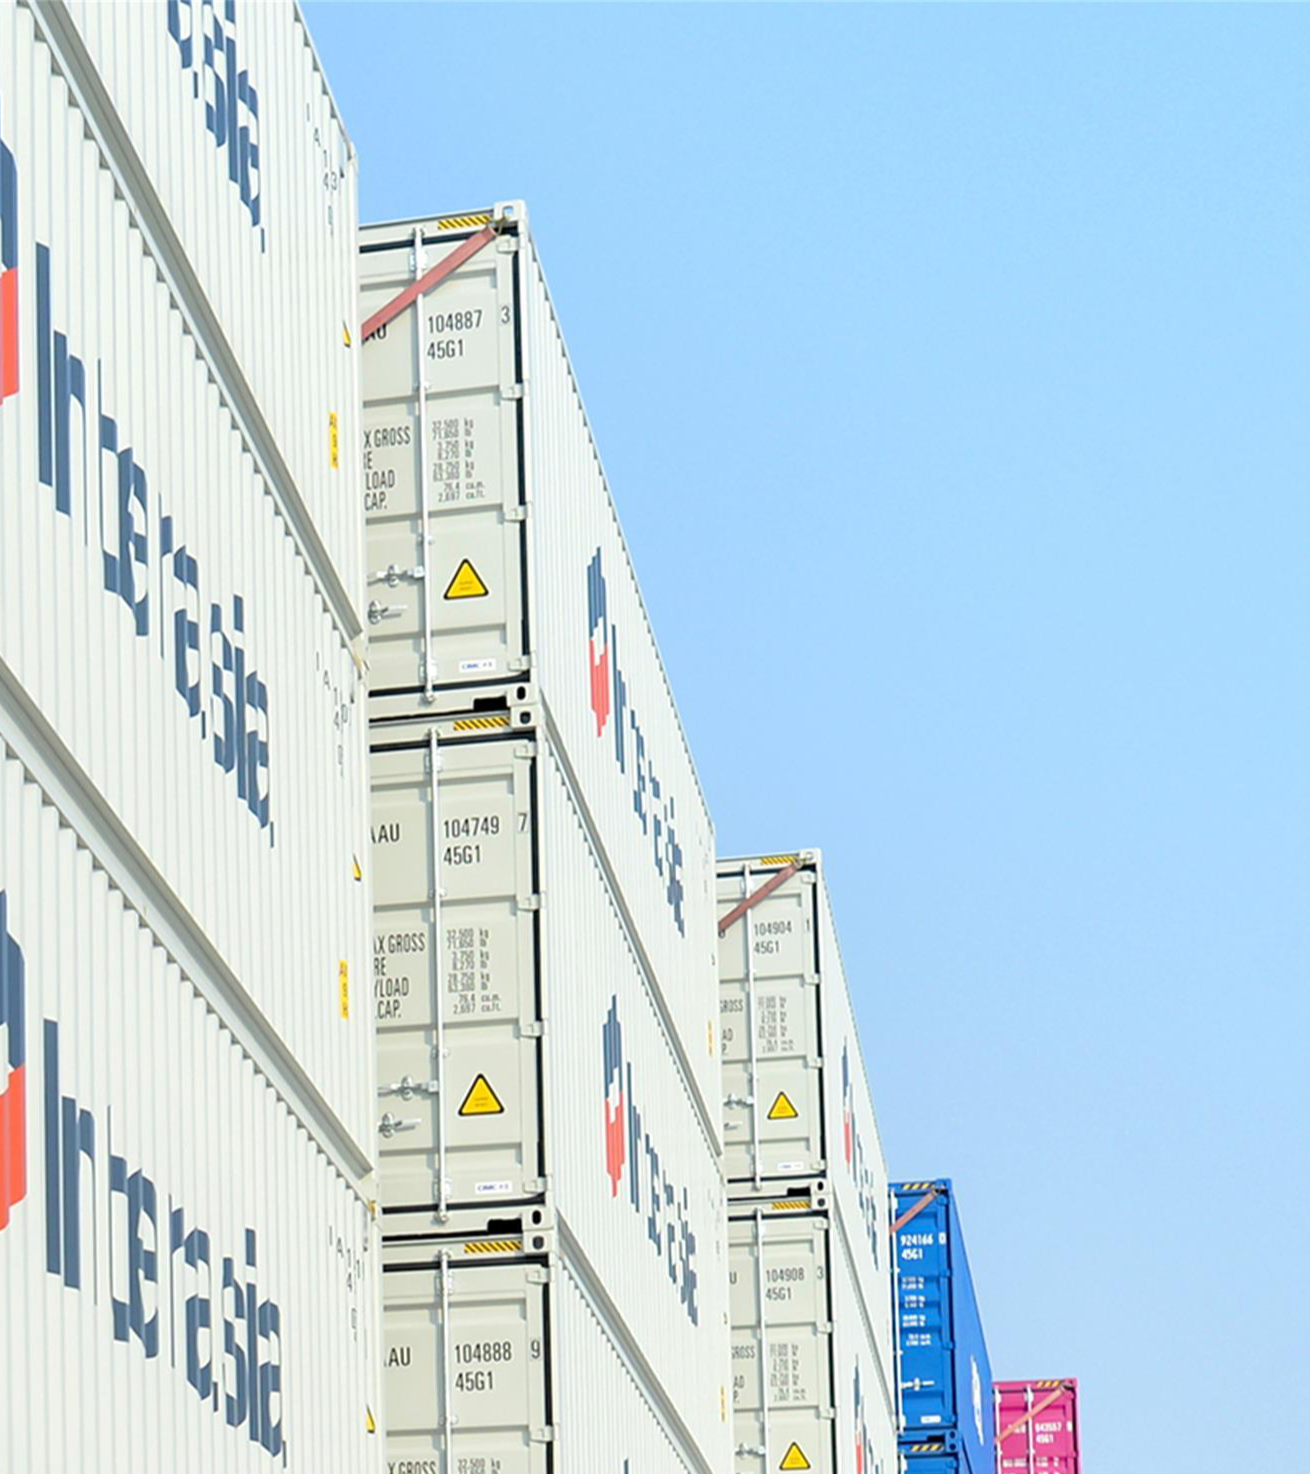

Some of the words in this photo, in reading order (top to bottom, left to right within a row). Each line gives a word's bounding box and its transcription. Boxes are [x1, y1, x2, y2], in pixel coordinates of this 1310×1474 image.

[428, 309, 483, 334] 104887
[500, 306, 511, 325] 3
[427, 338, 464, 361] 45G1
[374, 426, 412, 447] GROSS
[444, 815, 499, 838] 104749
[518, 813, 528, 832] 7
[444, 845, 480, 865] 45G1
[388, 933, 426, 952] GROSS
[753, 941, 779, 954] 45G1
[766, 1287, 792, 1300] 45G1
[384, 1347, 411, 1367] AU
[455, 1341, 512, 1364] 104888
[531, 1340, 542, 1359] 9
[455, 1371, 494, 1392] 45G1
